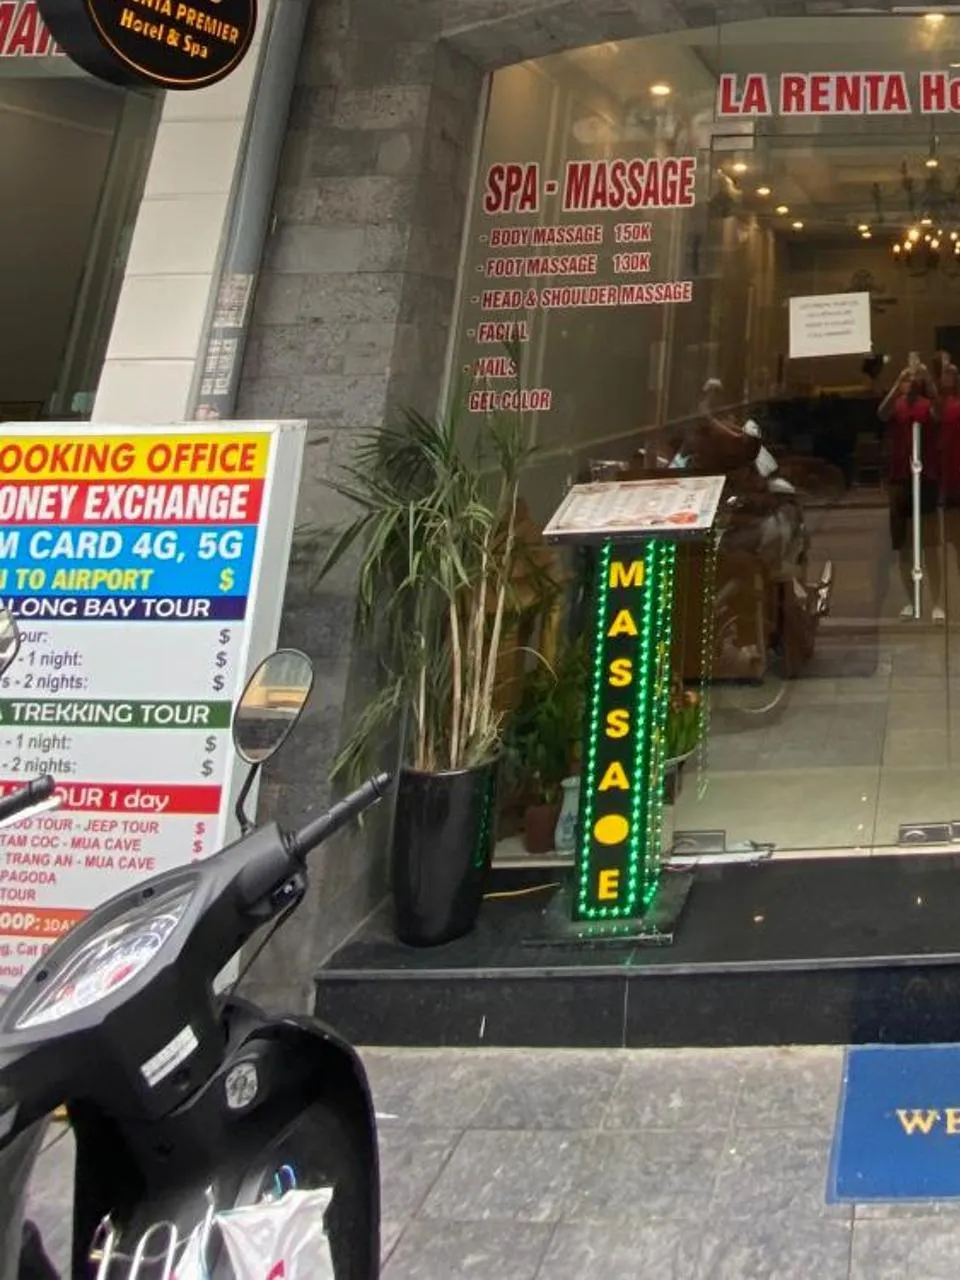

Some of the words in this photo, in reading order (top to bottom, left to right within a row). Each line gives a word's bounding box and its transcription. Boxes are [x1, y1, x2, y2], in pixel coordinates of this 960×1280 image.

[120, 8, 163, 41] Hotel
[166, 28, 180, 46] &
[183, 35, 209, 59] Spa
[176, 3, 240, 45] PREMIER
[719, 73, 771, 115] LA
[780, 72, 911, 115] RENTA
[484, 162, 539, 214] SPA
[563, 157, 697, 212] MASSAGE
[491, 228, 531, 247] BODY
[532, 226, 603, 246] MASSAGE
[614, 223, 652, 243] 150K
[486, 257, 524, 277] FOOT
[526, 255, 597, 275] MASSAGE
[613, 252, 650, 273] 130K
[481, 289, 522, 310] HEAD
[524, 288, 537, 308] &
[540, 285, 617, 307] SHOULDER
[619, 282, 692, 303] MASSAGE
[477, 321, 529, 342] FACIAL
[474, 357, 517, 377] NAILS
[469, 391, 498, 412] GEL
[501, 389, 551, 411] COLOR
[147, 443, 257, 473] OFFICE
[84, 484, 250, 519] EXCHANGE
[30, 532, 123, 559] CARD
[132, 531, 185, 563] 4G,
[198, 531, 243, 560] 5G
[16, 569, 45, 590] TO
[52, 569, 153, 590] AIRPORT
[219, 567, 234, 592] $
[84, 598, 136, 617] BAY
[142, 598, 210, 617] TOUR
[19, 631, 48, 642] our:
[219, 628, 230, 645] $
[28, 651, 36, 665] 1
[40, 650, 82, 670] night:
[215, 651, 227, 668] $
[23, 674, 33, 688] 2
[36, 674, 88, 693] nights:
[212, 674, 224, 691] $
[11, 702, 133, 723] TREKKING
[141, 704, 210, 724] TOUR
[16, 734, 24, 748] 1
[28, 733, 72, 752] night:
[205, 735, 217, 752] $
[11, 757, 21, 771] 2
[24, 757, 77, 775] nights:
[201, 760, 214, 777] $
[54, 786, 103, 807] OUR
[109, 790, 119, 808] 1
[124, 790, 170, 811] day
[36, 818, 72, 831] TOUR
[83, 819, 118, 832] JEEP
[122, 820, 158, 833] TOUR
[195, 822, 206, 835] $
[0, 835, 27, 847] TAM
[30, 836, 59, 848] COC
[71, 837, 100, 849] MUA
[105, 838, 141, 851] CAVE
[192, 840, 203, 853] $
[6, 853, 50, 866] TRANG
[54, 854, 73, 866] AN
[85, 855, 114, 868] MUA
[118, 857, 155, 870] CAVE
[0, 871, 56, 884] PAGODA
[0, 888, 36, 900] TOUR
